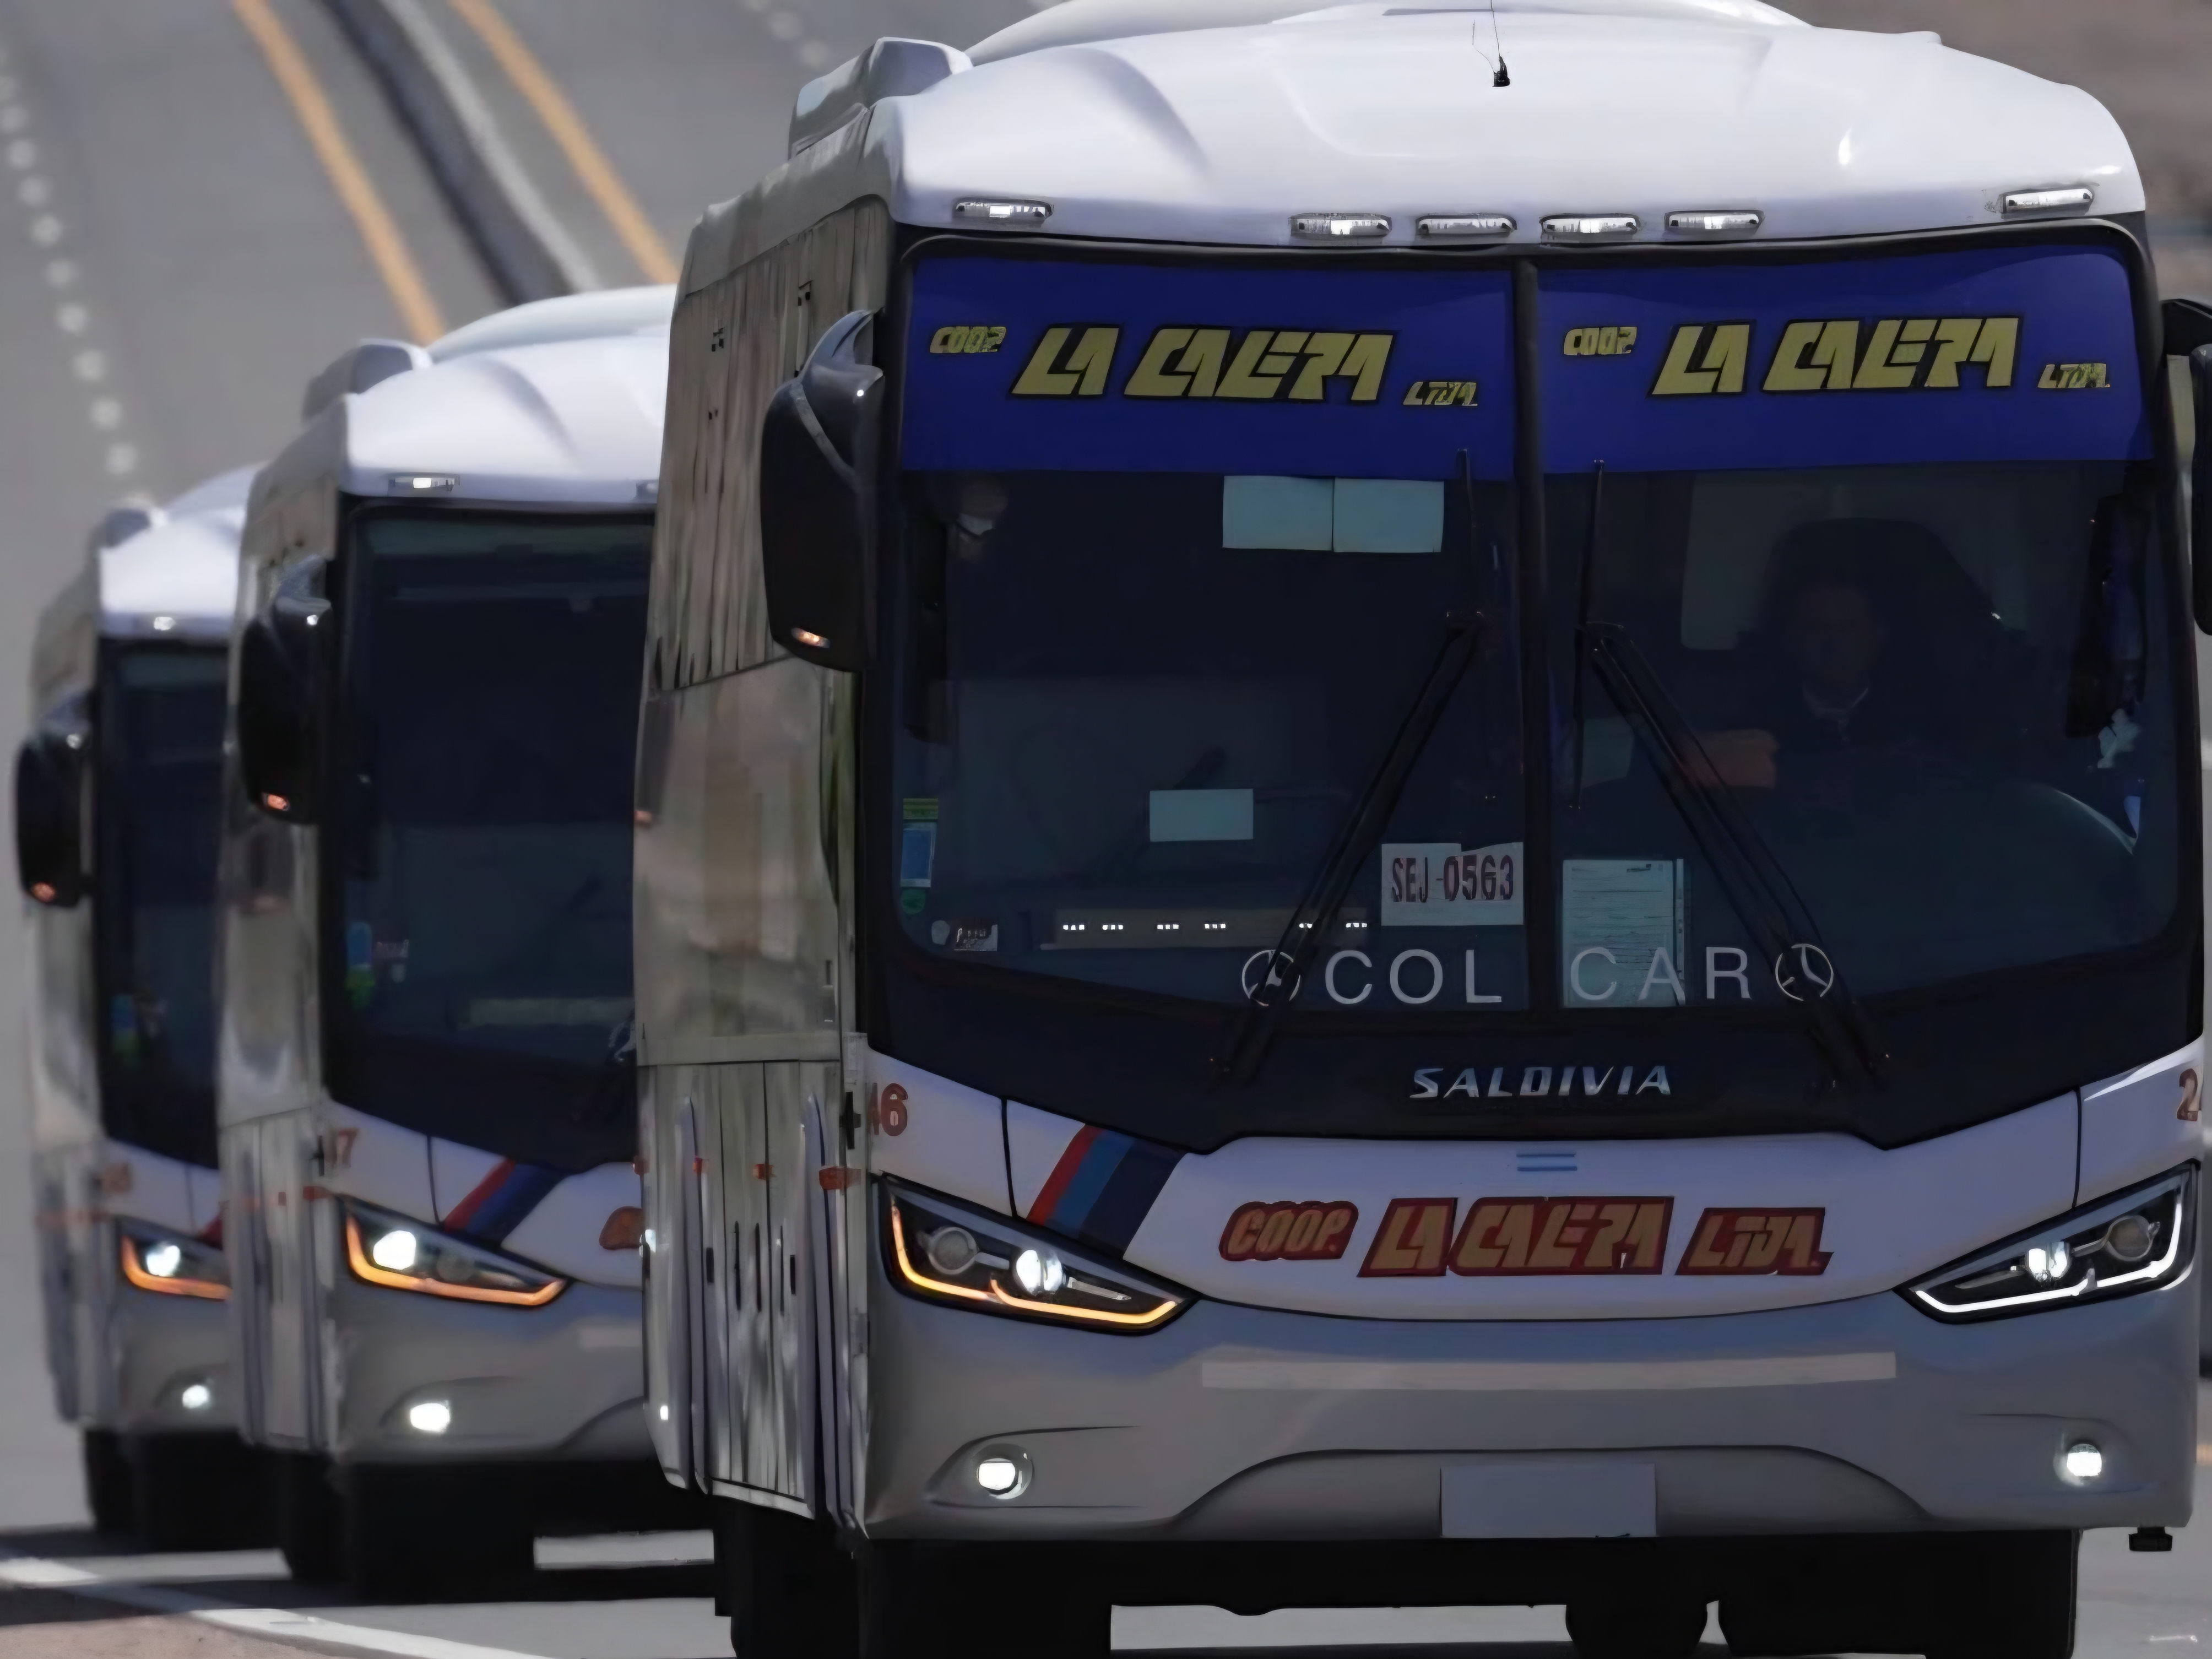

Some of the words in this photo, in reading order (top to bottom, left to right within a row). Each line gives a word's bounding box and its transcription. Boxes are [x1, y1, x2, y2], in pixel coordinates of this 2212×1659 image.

[1009, 327, 1120, 396] LA
[1123, 328, 1395, 402] CALERA
[1651, 323, 1751, 395] LA
[1761, 317, 2019, 391] CALERA
[1324, 948, 1503, 1005] COL
[1569, 945, 1753, 1006] CAR
[1409, 1065, 1671, 1099] SALDIVIA
[1368, 1204, 1451, 1270] LA
[1454, 1202, 1666, 1270] CALERA
